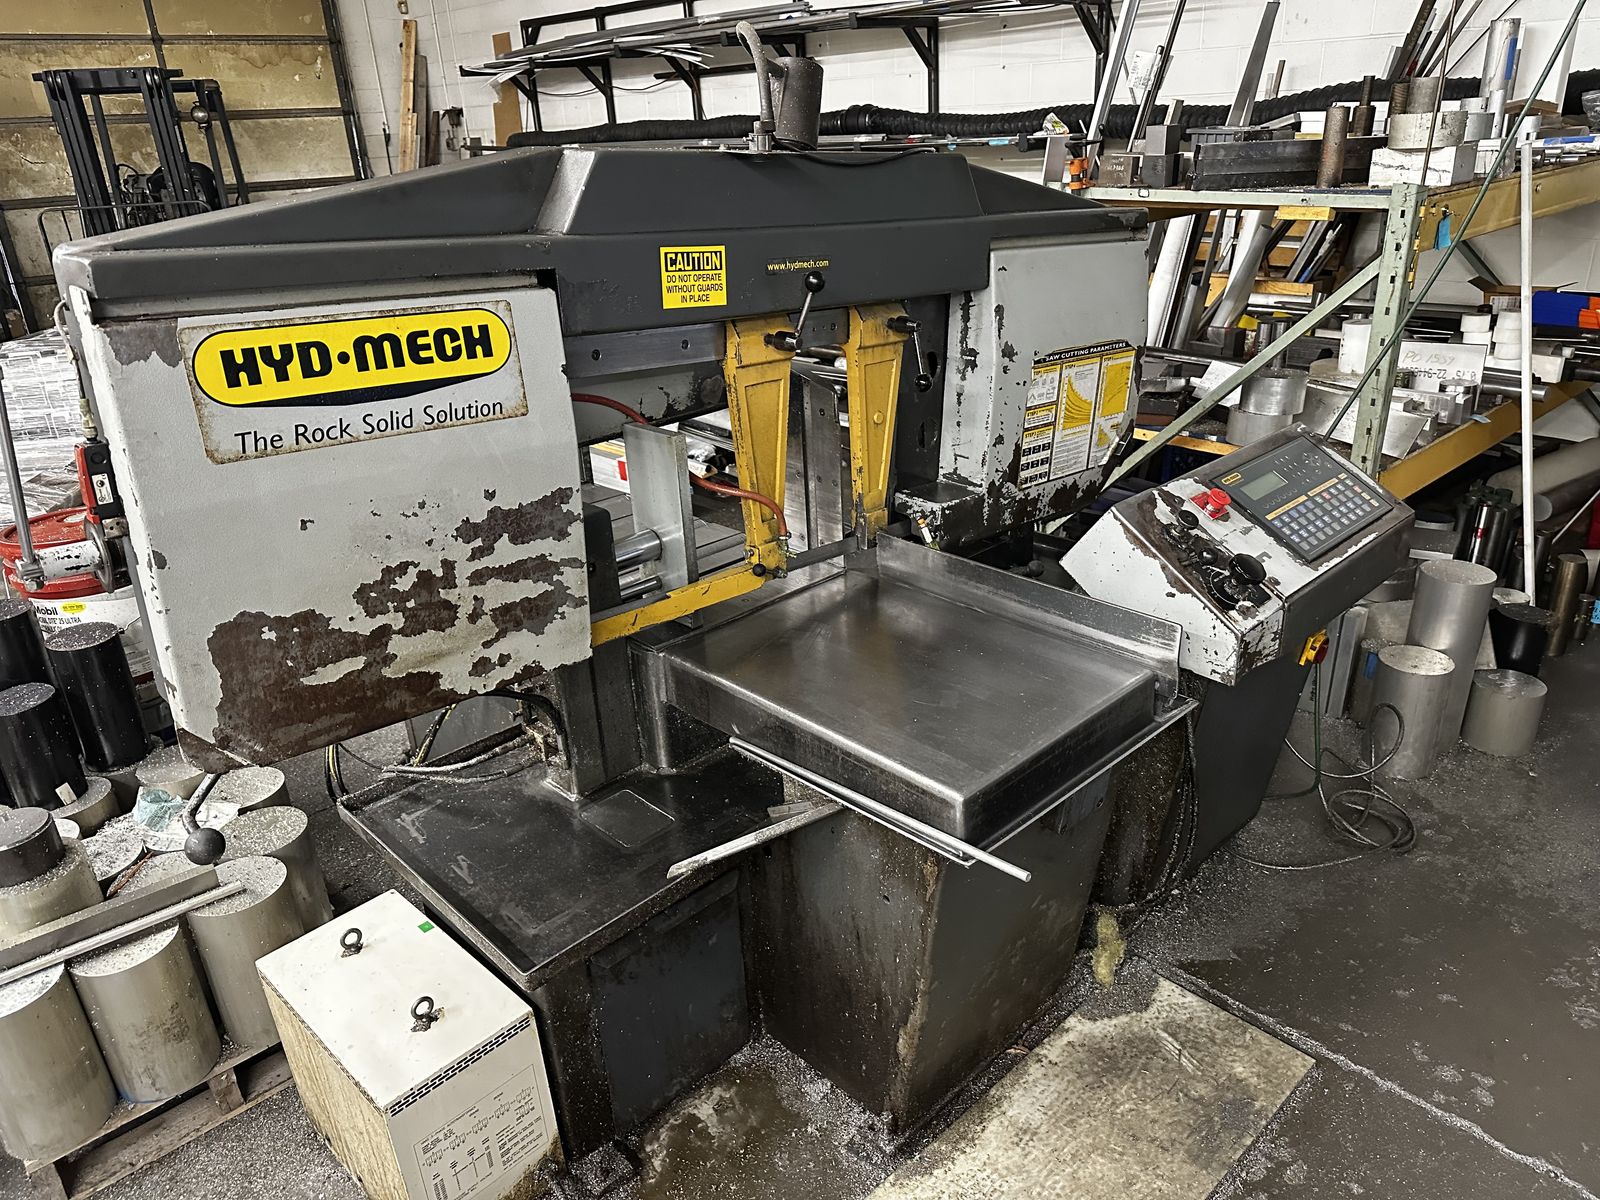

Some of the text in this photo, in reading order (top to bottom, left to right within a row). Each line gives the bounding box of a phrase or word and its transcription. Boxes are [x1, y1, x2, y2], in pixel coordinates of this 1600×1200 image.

[666, 252, 721, 272] CAUTION
[767, 259, 829, 272] www.hydmech.com
[666, 273, 722, 283] DO NOT OPERATE
[666, 283, 723, 294] WITHOUT GUARDS
[681, 294, 710, 304] IN PLACE
[1045, 354, 1061, 362] SAW
[1061, 349, 1089, 358] CUTTING
[234, 399, 504, 455] The Rock Solid Solution
[35, 606, 58, 616] Mobil
[65, 617, 82, 625] ULTRA
